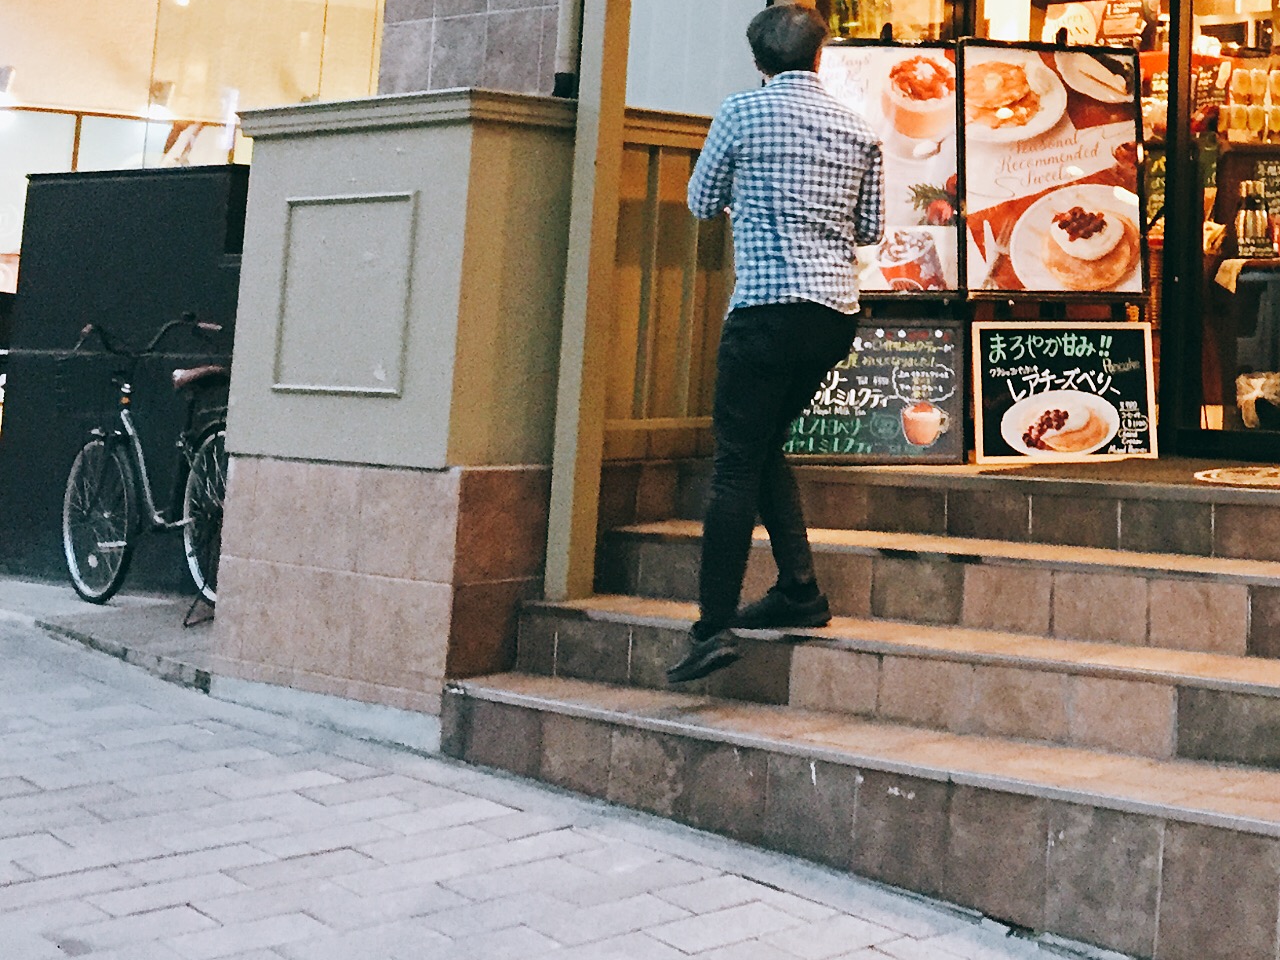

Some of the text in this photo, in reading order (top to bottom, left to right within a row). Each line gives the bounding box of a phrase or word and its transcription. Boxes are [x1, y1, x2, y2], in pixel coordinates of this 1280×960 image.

[1006, 366, 1121, 403] レアチーズベリー
